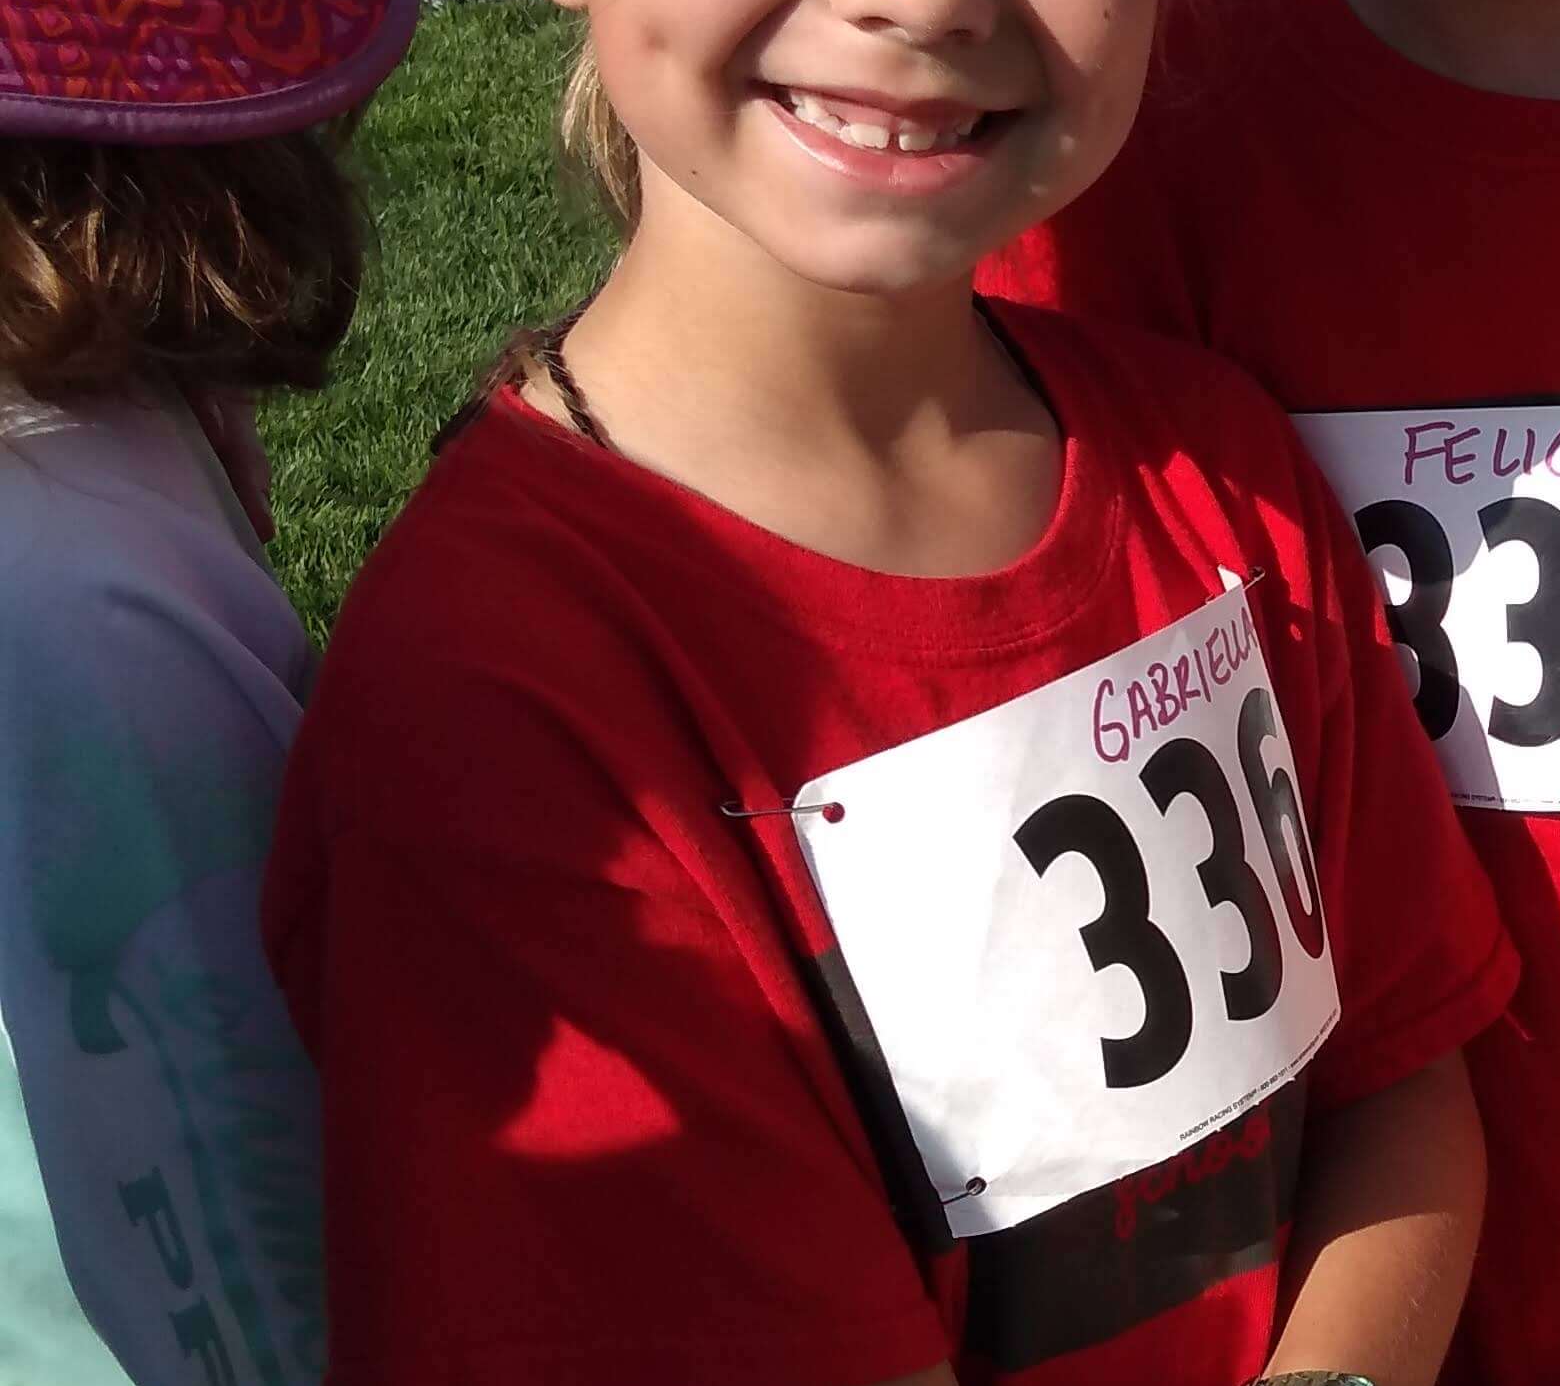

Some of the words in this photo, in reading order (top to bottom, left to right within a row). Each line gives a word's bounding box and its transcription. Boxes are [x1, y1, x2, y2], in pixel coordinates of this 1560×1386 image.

[1093, 606, 1259, 763] GABRIELLA
[1011, 686, 1326, 1090] 336
[1179, 1117, 1209, 1142] RAINBOW
[1208, 1104, 1233, 1124] RACING
